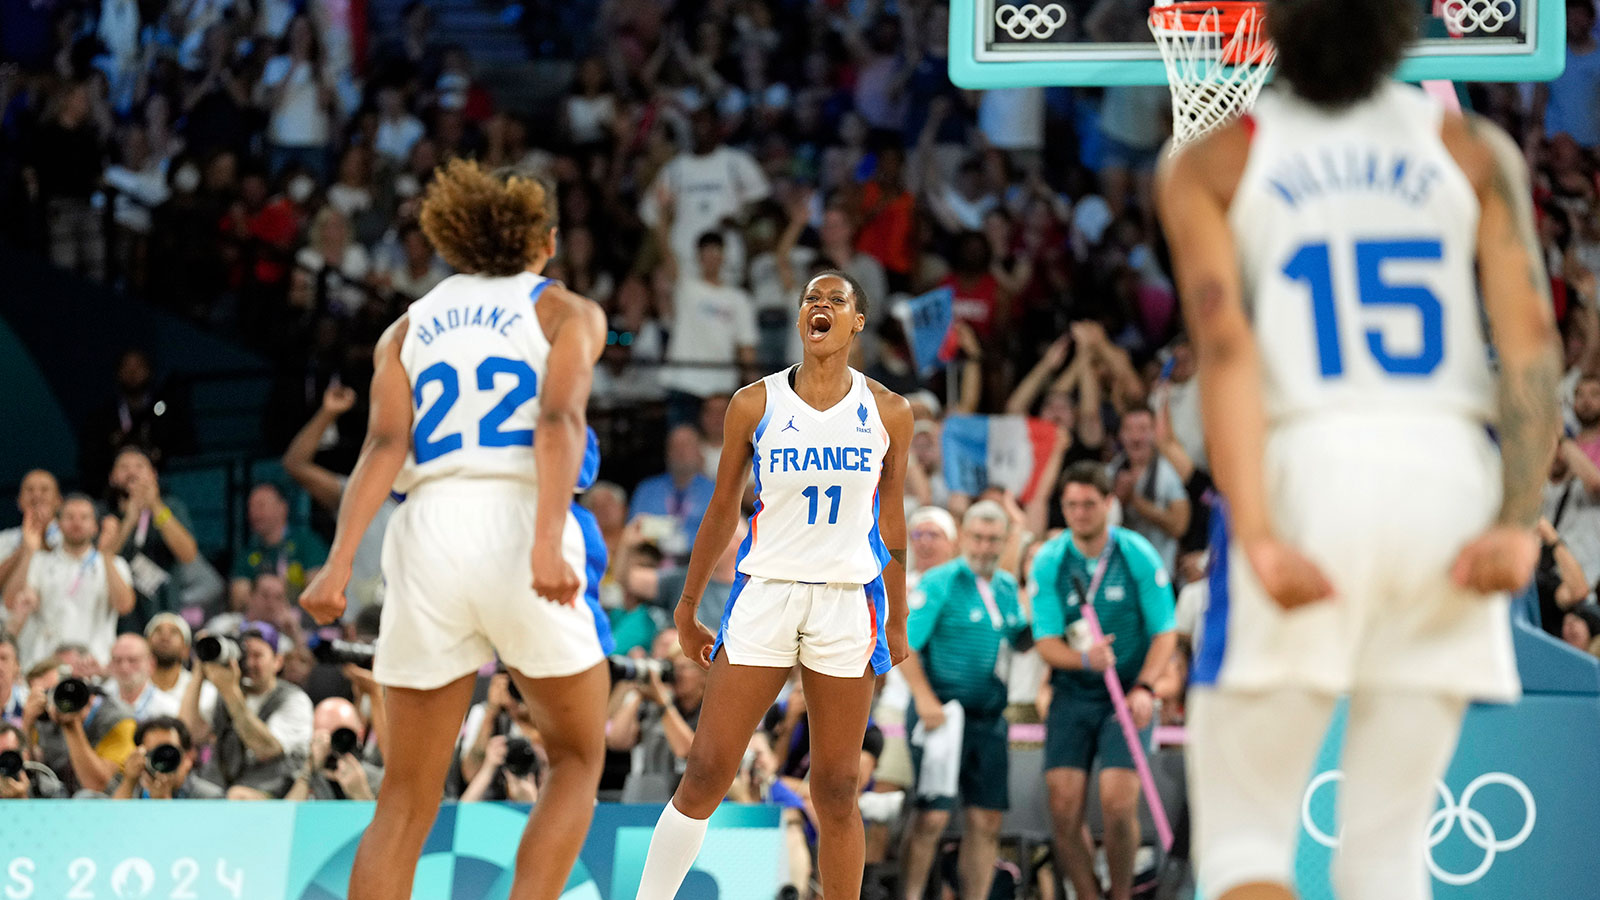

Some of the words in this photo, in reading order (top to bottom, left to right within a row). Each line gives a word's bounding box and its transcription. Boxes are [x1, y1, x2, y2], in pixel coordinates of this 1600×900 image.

[416, 305, 521, 346] BADIANE
[1280, 239, 1443, 377] 15
[413, 356, 538, 465] 22
[856, 426, 872, 434] FRANCE
[769, 446, 872, 473] FRANCE
[801, 485, 842, 525] 11
[65, 856, 245, 899] 2024
